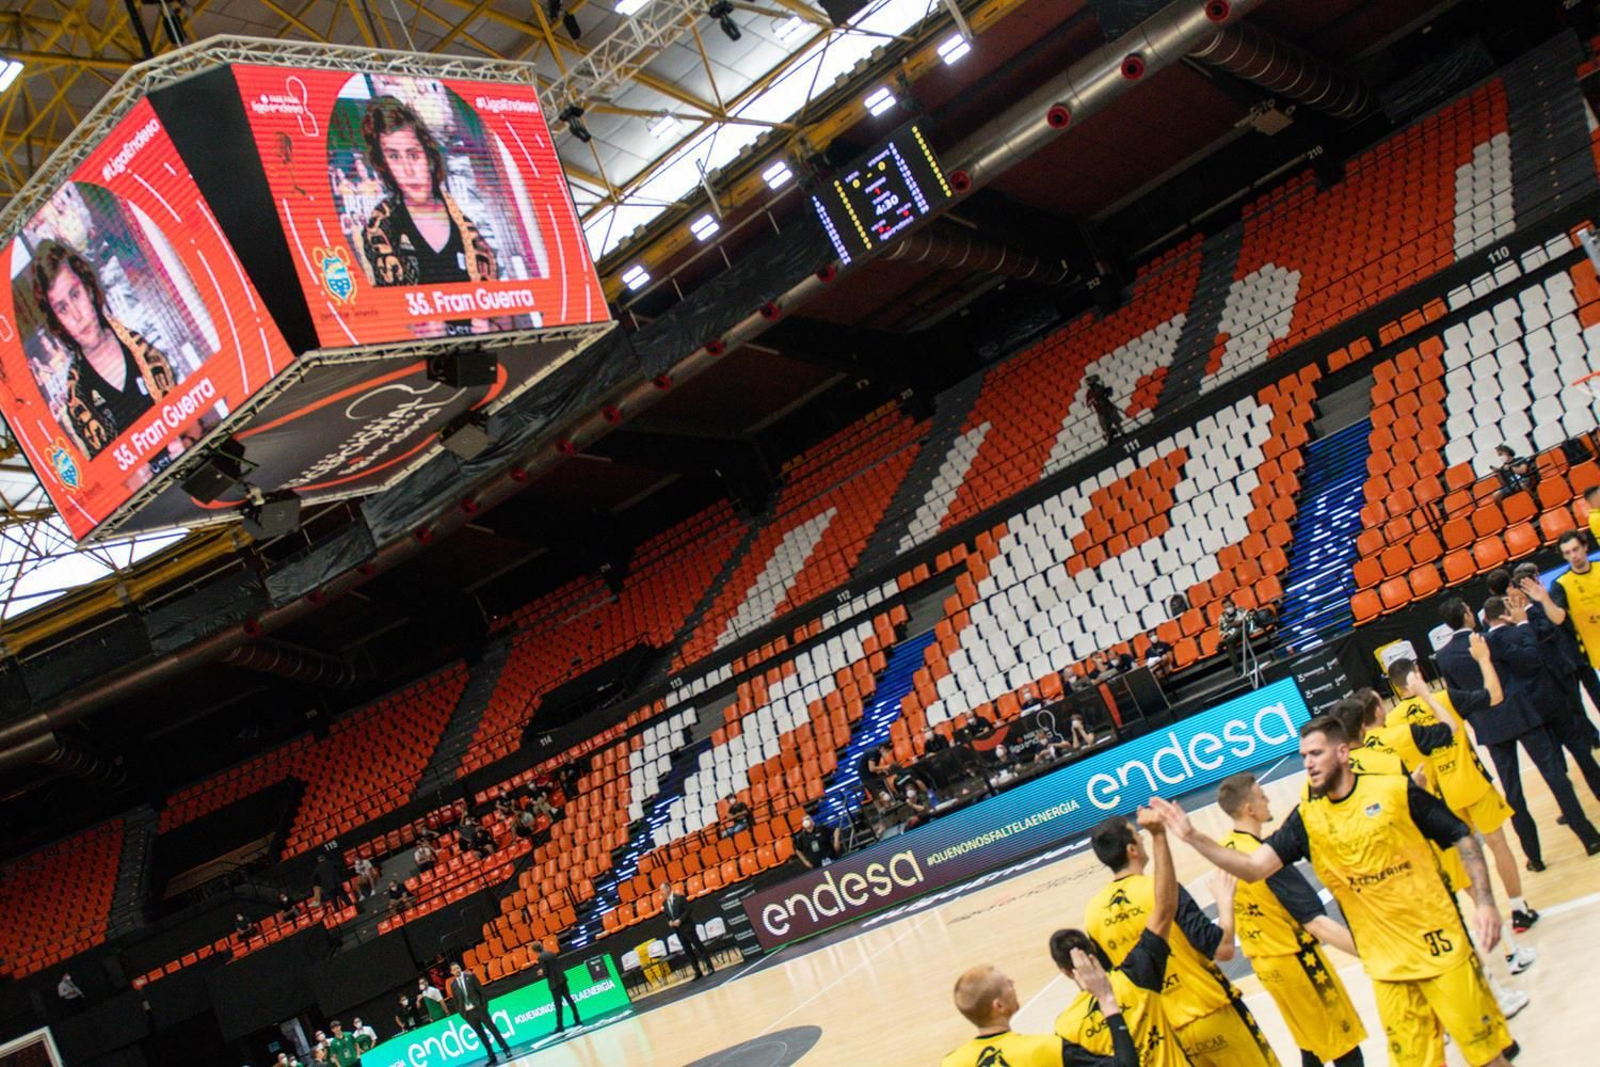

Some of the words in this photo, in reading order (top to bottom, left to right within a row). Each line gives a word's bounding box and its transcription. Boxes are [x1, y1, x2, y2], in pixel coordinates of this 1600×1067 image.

[876, 194, 899, 216] 4:30
[1487, 246, 1511, 264] 110
[405, 290, 434, 317] 35.
[435, 289, 475, 314] Fran
[474, 288, 535, 311] Guerra
[131, 418, 168, 456] Fran
[161, 377, 216, 428] Guerra
[1123, 438, 1140, 453] 111
[836, 590, 851, 603] 112
[1087, 701, 1298, 810] endesa
[762, 850, 925, 936] endesa
[1423, 928, 1453, 957] 35
